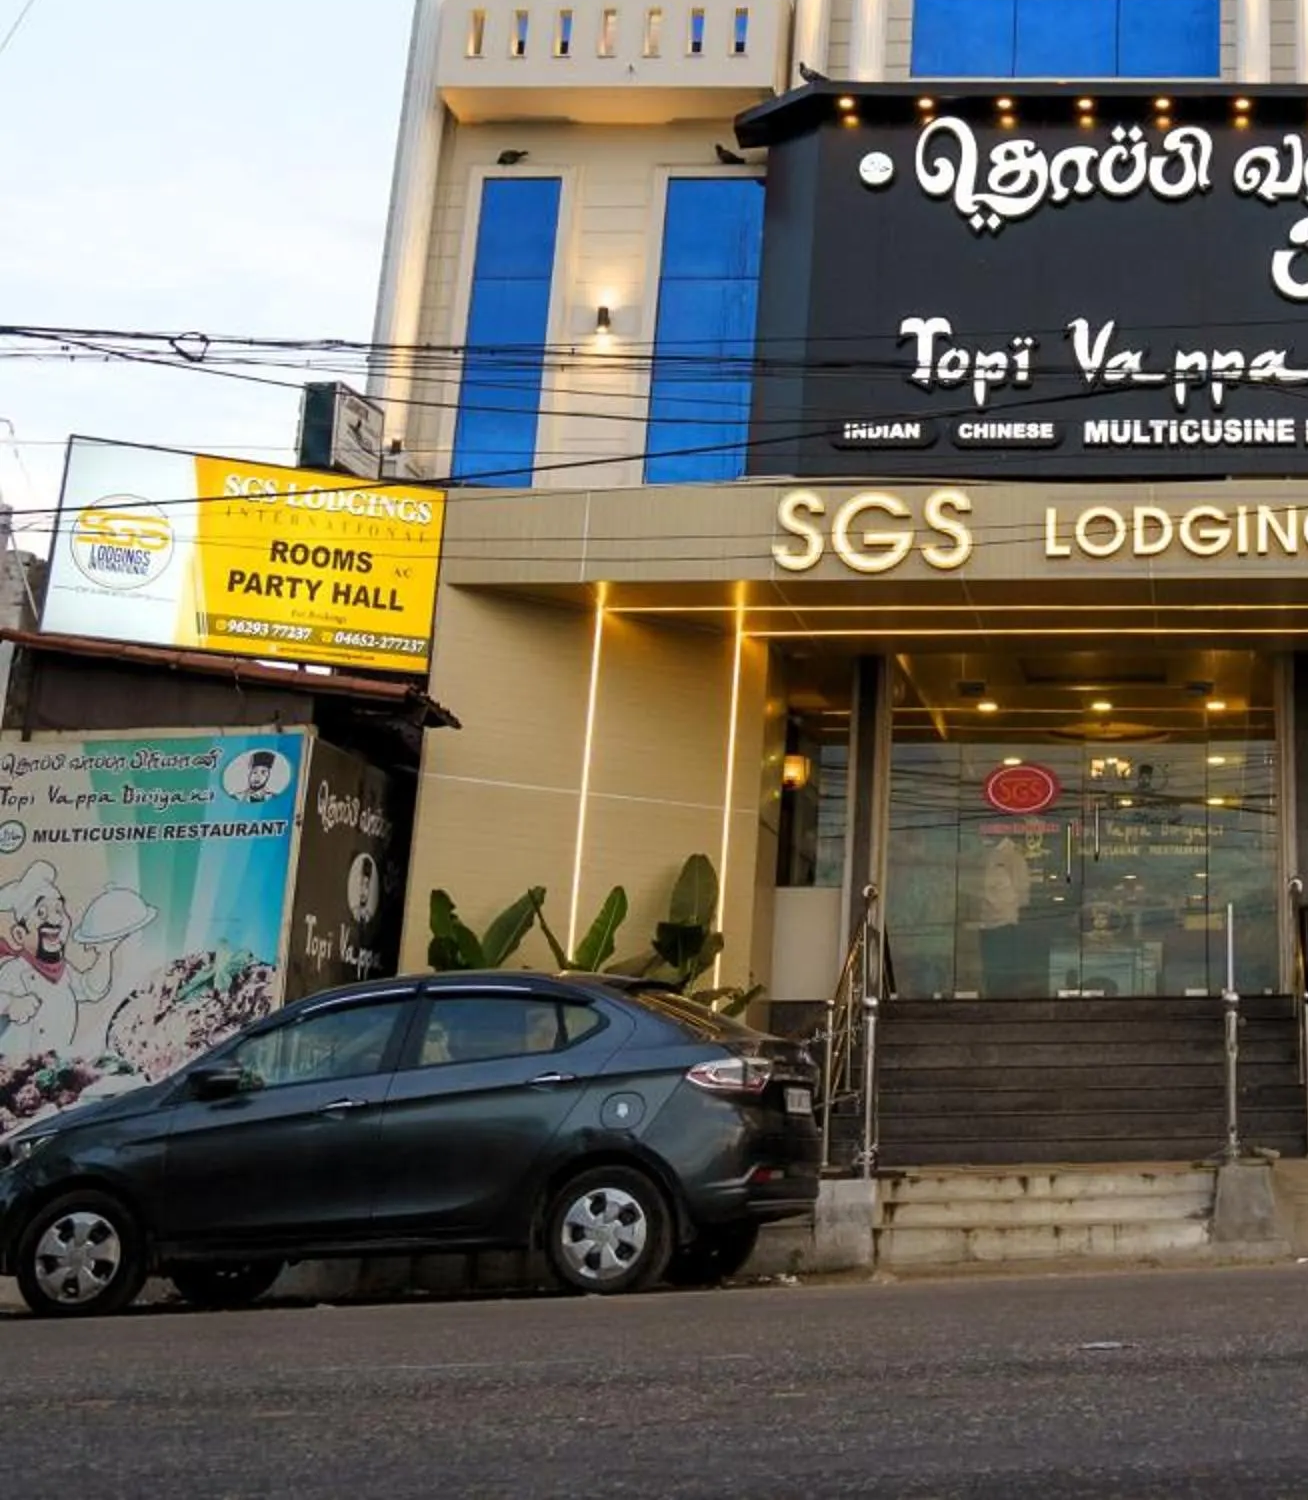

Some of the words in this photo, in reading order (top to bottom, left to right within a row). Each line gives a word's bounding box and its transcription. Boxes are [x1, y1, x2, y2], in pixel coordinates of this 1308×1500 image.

[843, 423, 921, 440] INDIAN
[958, 423, 1055, 440] CHINESE
[1084, 418, 1296, 444] MULTICUSINE
[223, 472, 279, 505] SGS
[286, 483, 433, 524] LODGINGS
[772, 486, 973, 573] SGS
[269, 540, 374, 573] ROOMS
[227, 570, 323, 602] PARTY
[331, 582, 405, 612] HALL
[227, 618, 269, 637] 96293
[48, 784, 117, 810] Vappa
[997, 778, 1042, 800] SGS
[32, 825, 158, 844] MULTICUSINE
[163, 821, 286, 839] RESTAURANT
[305, 914, 333, 971] Topi
